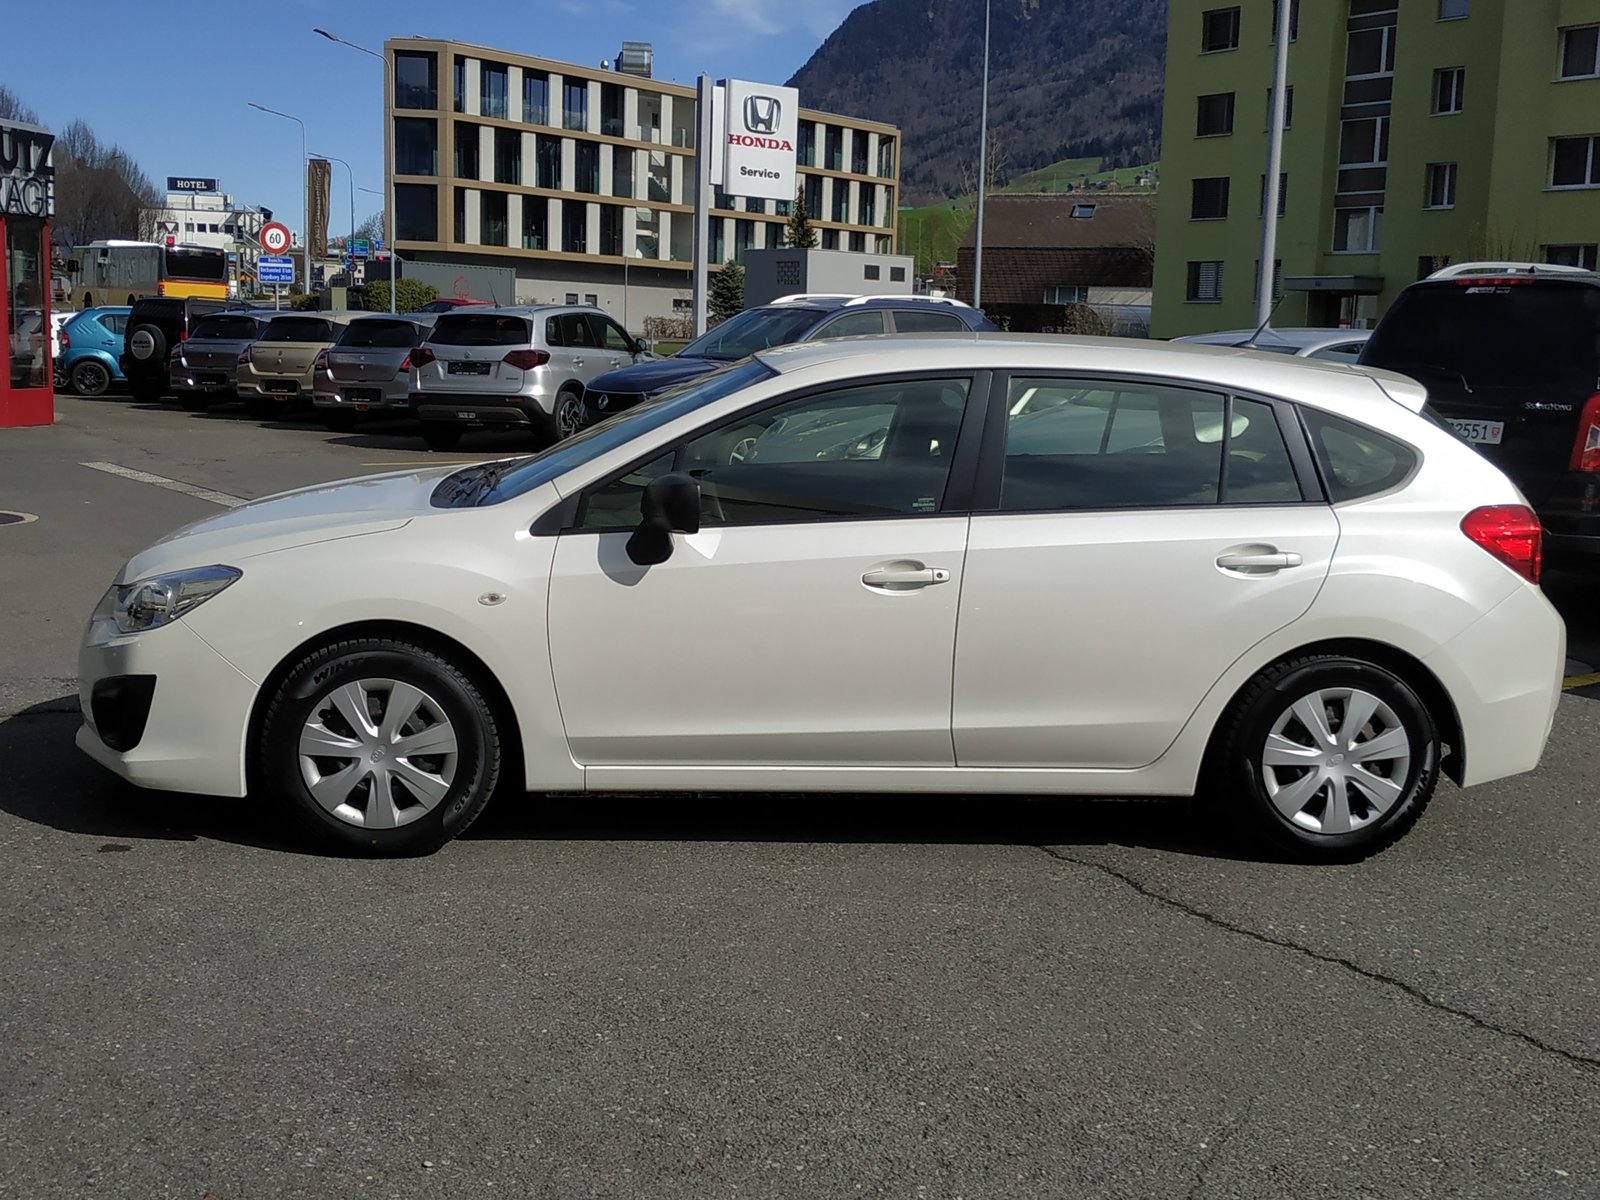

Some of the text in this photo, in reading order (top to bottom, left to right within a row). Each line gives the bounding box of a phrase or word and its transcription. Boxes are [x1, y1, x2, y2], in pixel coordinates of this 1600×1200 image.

[728, 134, 793, 152] HONDA
[740, 166, 781, 179] Service
[176, 180, 207, 189] HOTEL
[0, 176, 55, 217] AGE
[269, 233, 281, 244] 60
[1450, 422, 1488, 440] 2551
